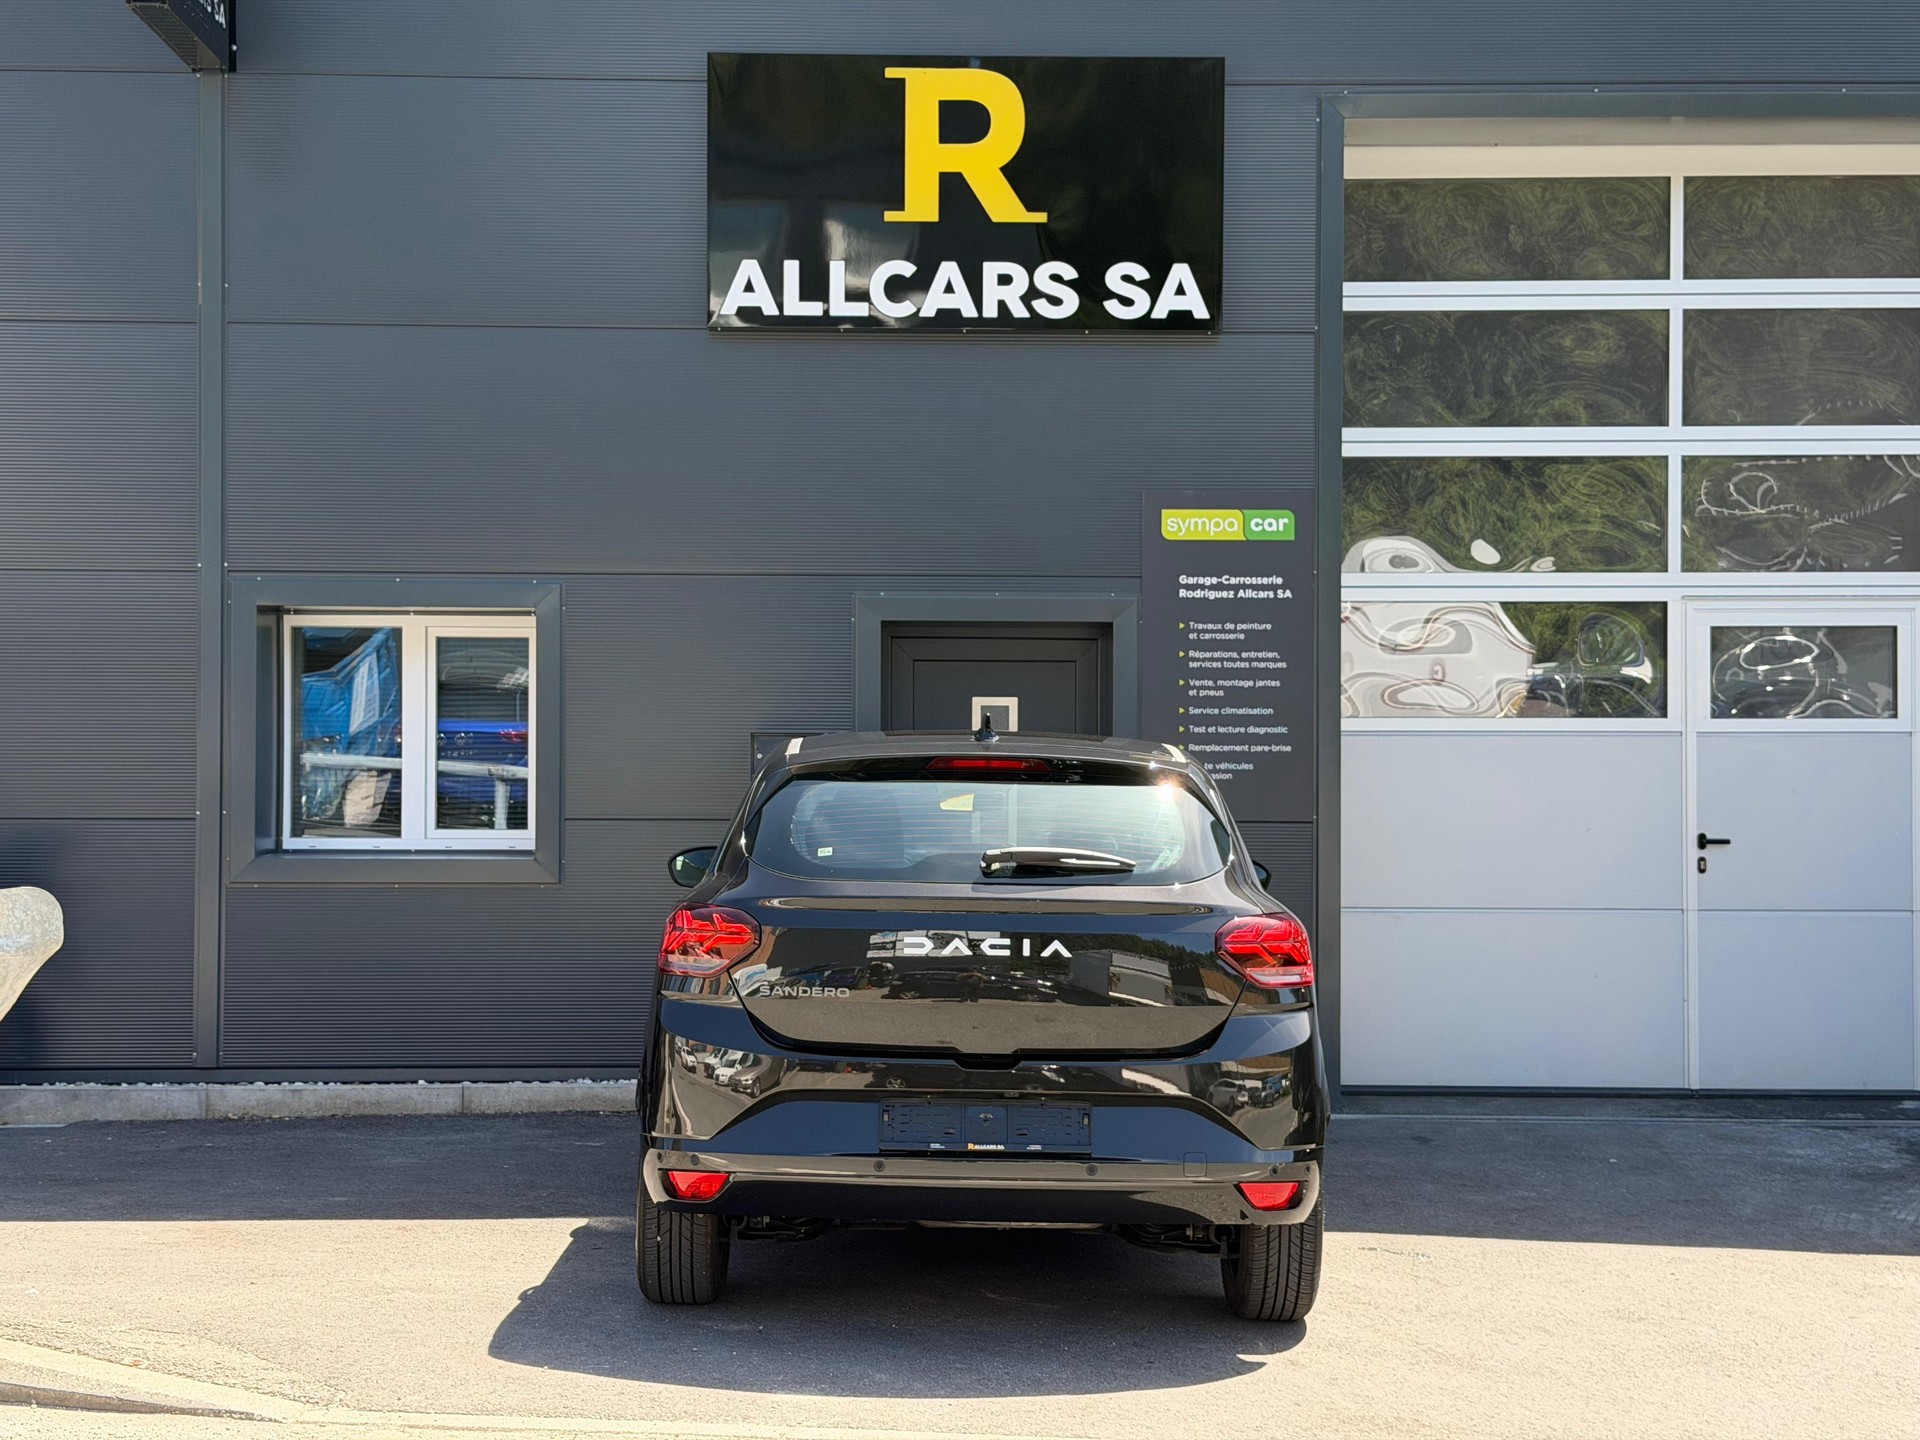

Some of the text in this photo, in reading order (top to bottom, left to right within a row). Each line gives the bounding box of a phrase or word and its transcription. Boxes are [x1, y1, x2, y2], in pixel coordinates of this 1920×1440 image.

[884, 67, 1048, 222] R
[720, 259, 1210, 320] ALLCARS SA
[1166, 517, 1289, 536] sympa car
[1178, 575, 1283, 585] Garage-Carrosserie
[1178, 589, 1293, 600] Rodriguez Allcars SA
[1188, 622, 1272, 632] Travaux de peinture
[1199, 632, 1245, 640] carrosserie
[1188, 650, 1281, 660] Réparations, entretien,
[1188, 660, 1287, 670] services toutes marques
[1188, 679, 1281, 688] Vente, montage jantes
[1199, 689, 1225, 697] pneus
[1188, 707, 1274, 715] Service climatisation
[1188, 726, 1206, 734] Test
[1217, 726, 1245, 734] lecture
[1246, 726, 1288, 735] diagnostic
[1188, 744, 1292, 753] Remplacement pare-brise
[1215, 761, 1254, 770] véhicules
[903, 936, 1073, 958] DACIA
[759, 985, 850, 998] SANDERO
